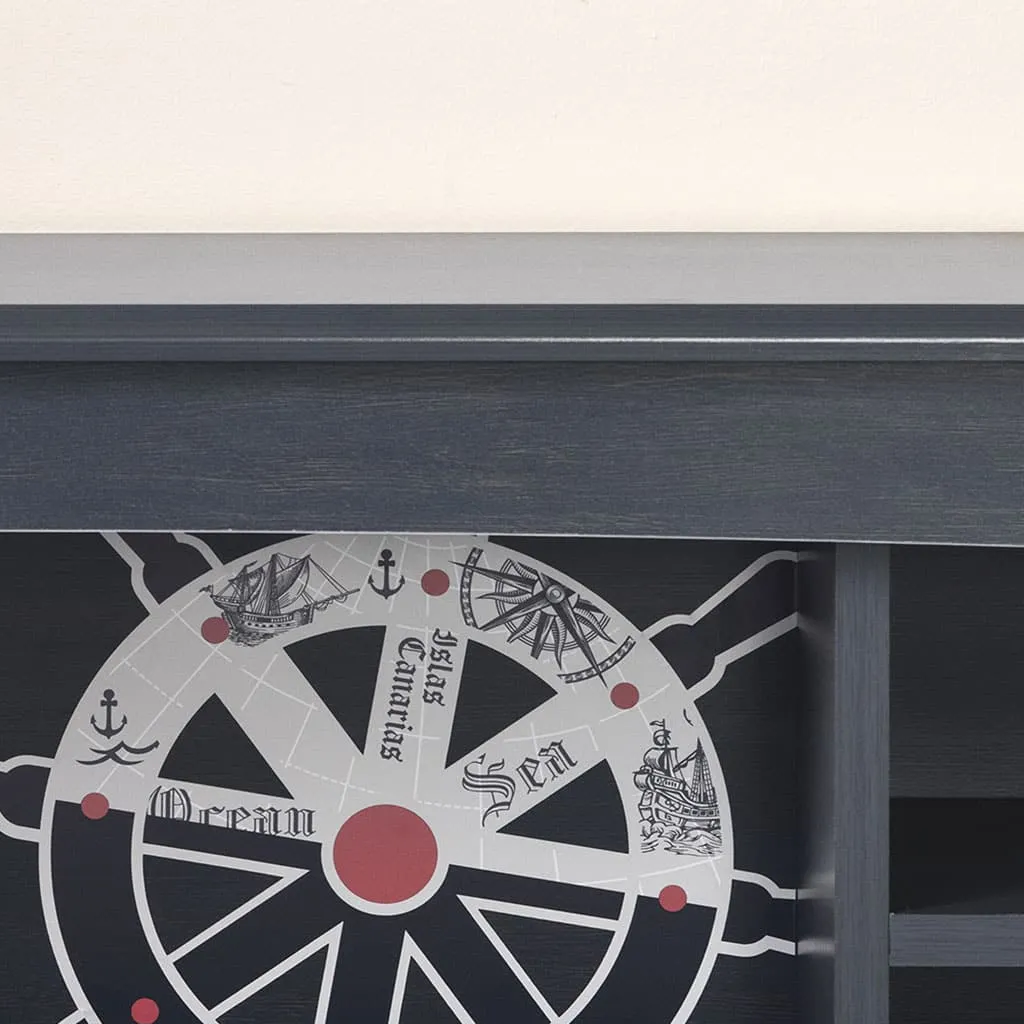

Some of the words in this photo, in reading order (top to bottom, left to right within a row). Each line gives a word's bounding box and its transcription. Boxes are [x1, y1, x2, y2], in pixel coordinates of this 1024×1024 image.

[379, 636, 427, 763] Canarias
[422, 627, 458, 707] Islas
[147, 785, 316, 837] Ocean
[461, 739, 578, 828] Sea
